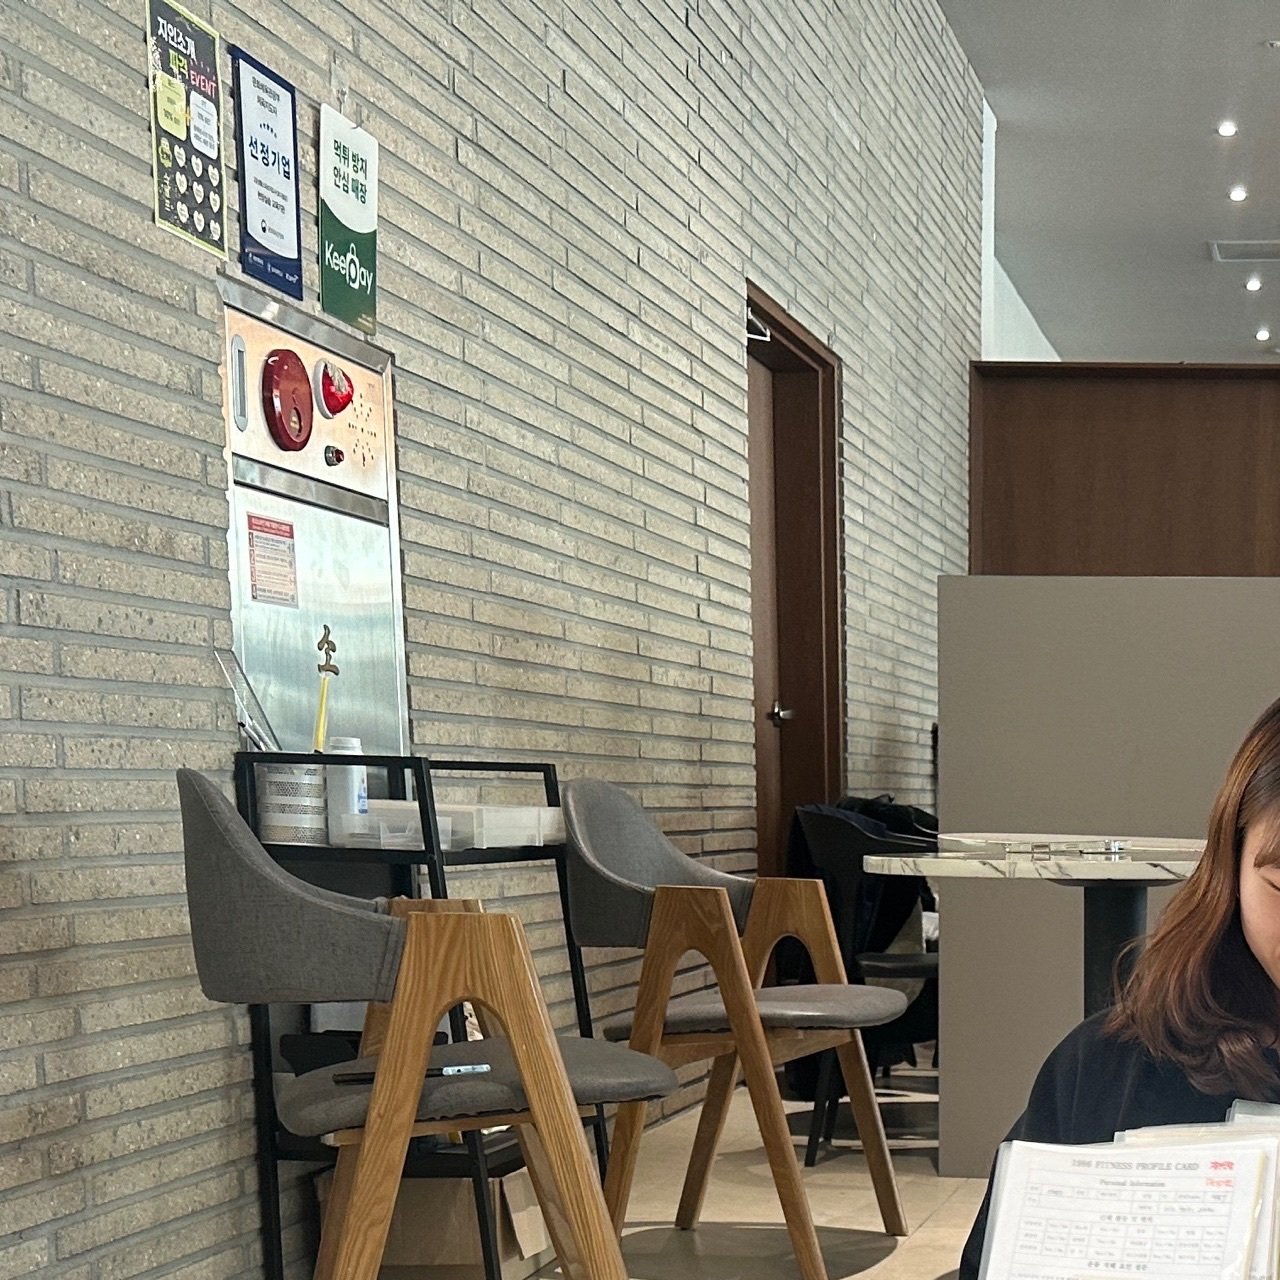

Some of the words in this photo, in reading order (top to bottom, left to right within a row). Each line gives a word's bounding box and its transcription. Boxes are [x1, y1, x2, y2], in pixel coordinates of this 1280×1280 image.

[157, 16, 197, 62] 지인소개
[190, 70, 216, 99] EVENT
[249, 136, 290, 180] 선정기업
[333, 139, 350, 168] 먹튀
[351, 151, 368, 180] 방지
[333, 166, 349, 194] 안심
[1095, 1160, 1133, 1170] FITNESS
[1136, 1161, 1172, 1171] PROFILE
[1175, 1162, 1200, 1171] CARD
